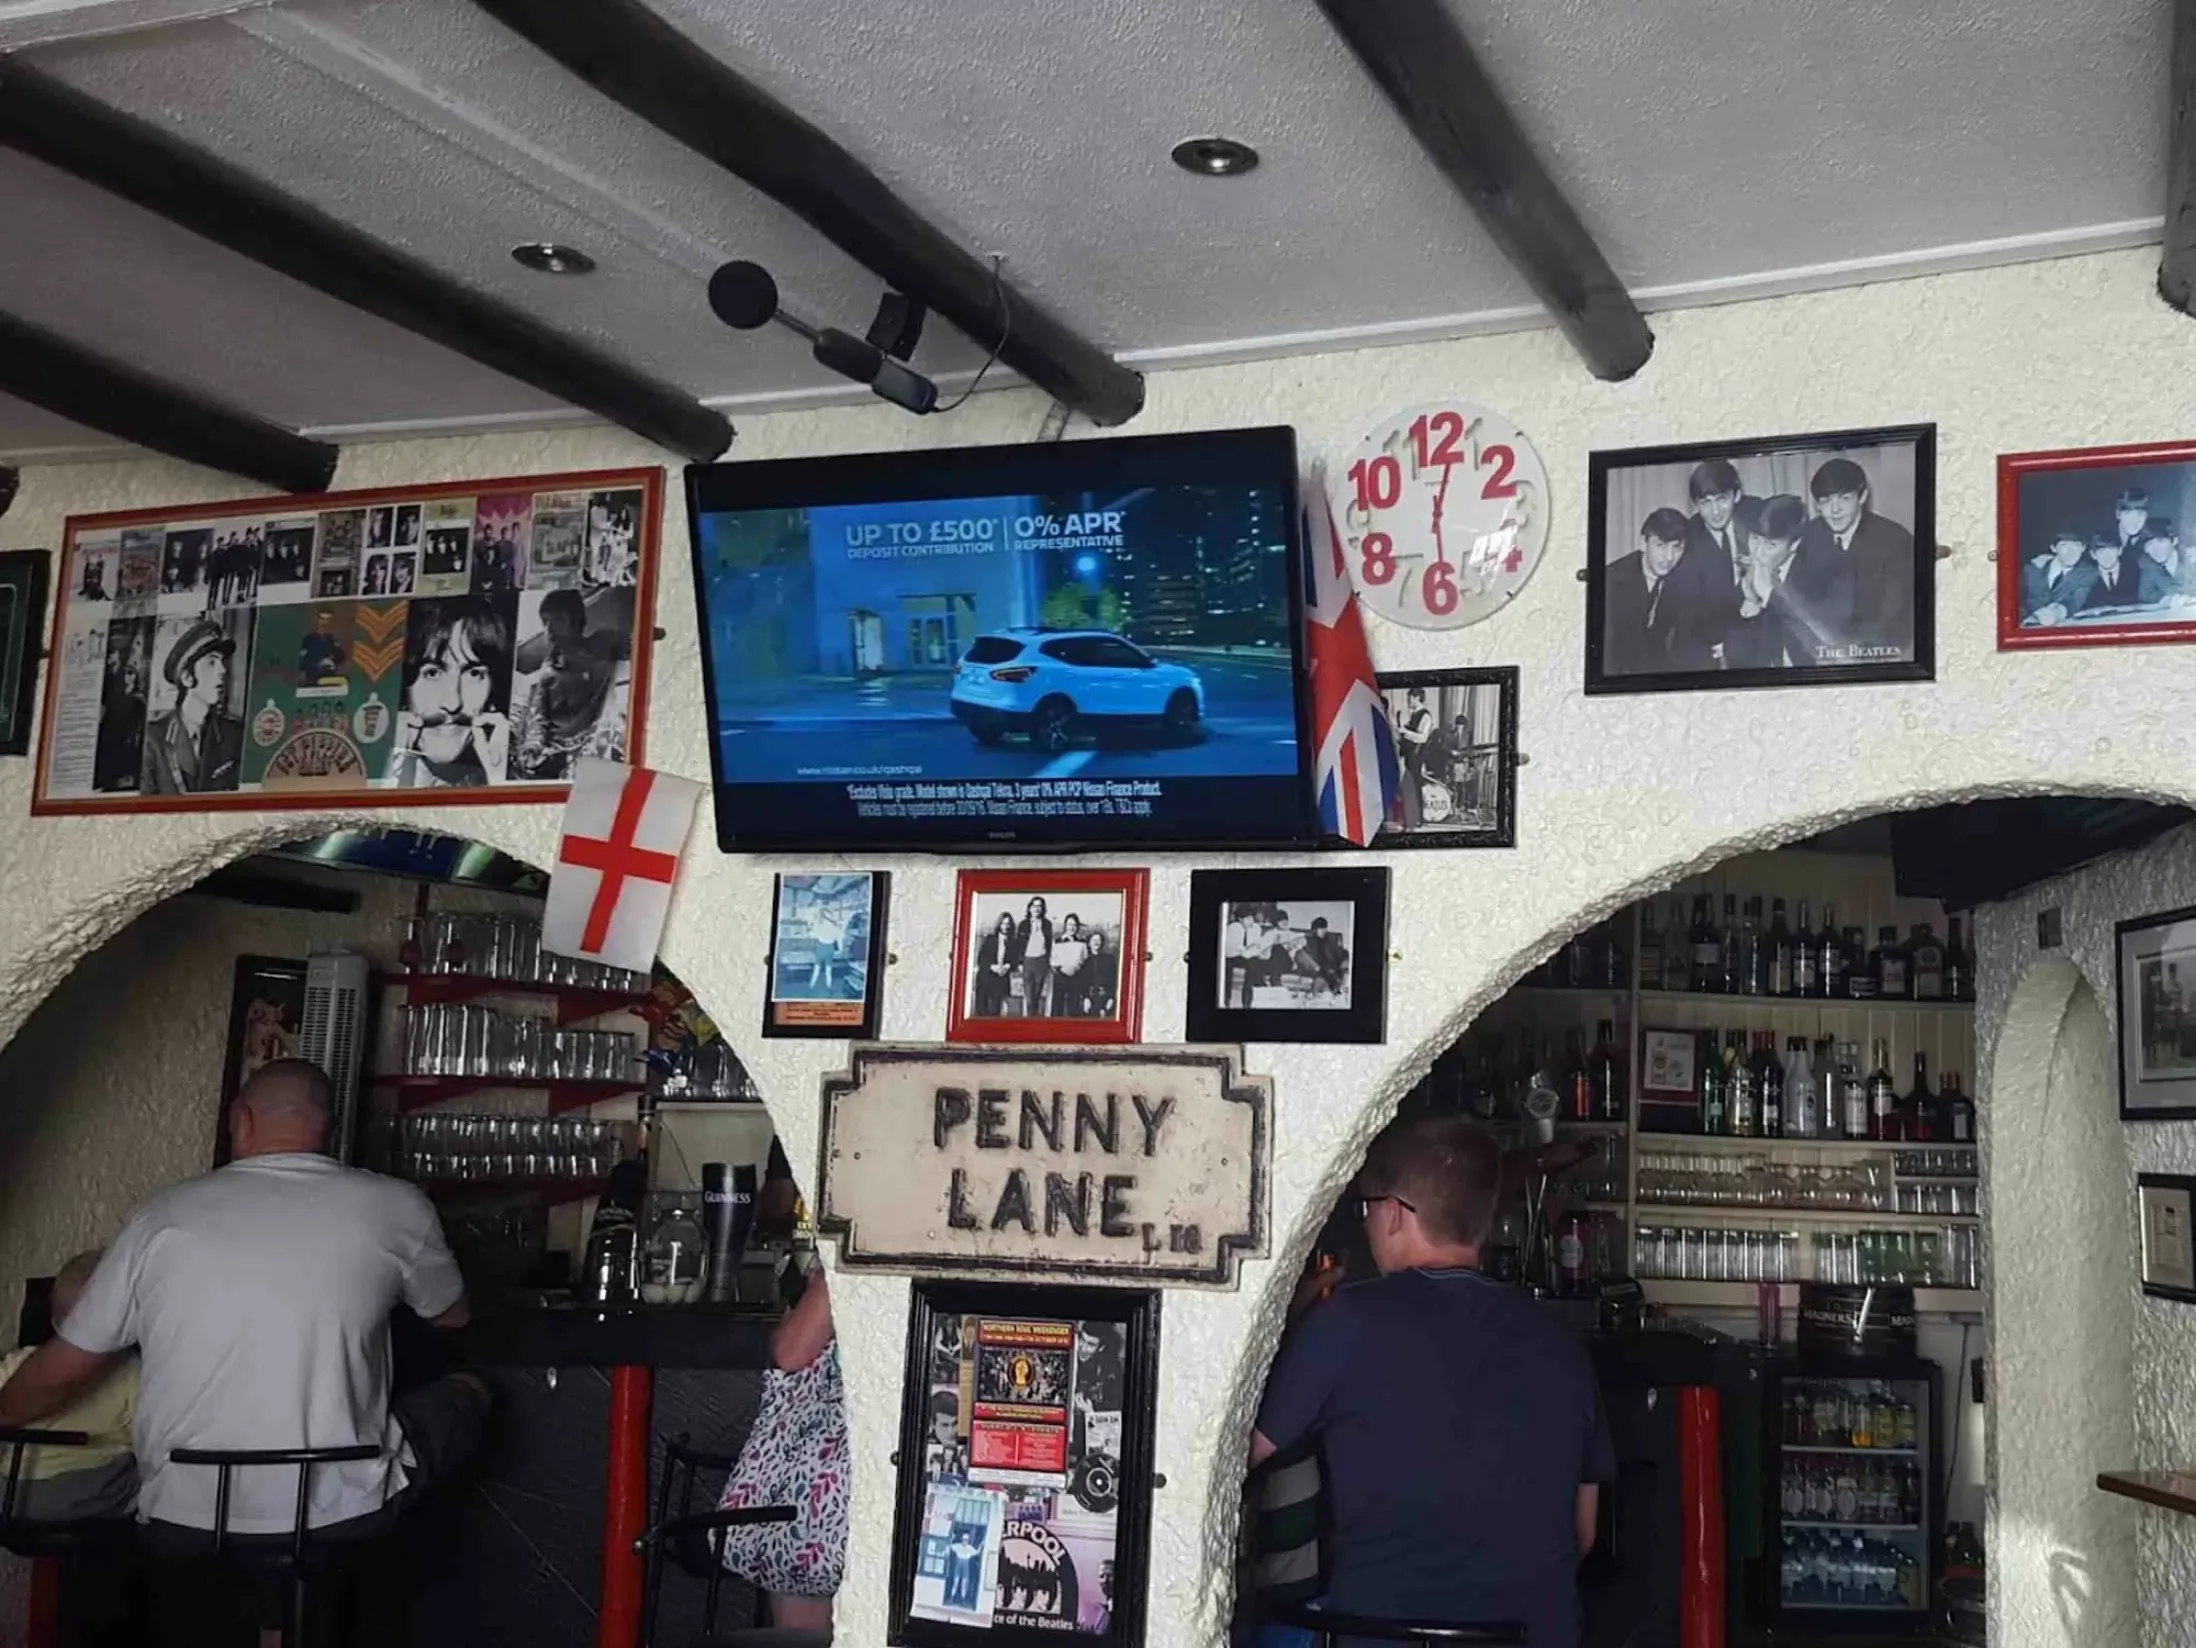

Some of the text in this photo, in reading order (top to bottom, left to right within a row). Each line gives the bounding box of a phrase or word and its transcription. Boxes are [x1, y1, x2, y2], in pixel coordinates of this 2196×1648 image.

[1409, 411, 1464, 467] 12
[1348, 456, 1402, 511] 10
[1480, 444, 1517, 500] 2
[845, 523, 880, 545] UP
[887, 522, 922, 544] TO
[847, 542, 994, 559] DEPOSIT CONTRIBUTION
[1014, 514, 1059, 538] 0%
[1014, 534, 1125, 551] REPRESENTATIVE
[1361, 532, 1396, 586] 8
[1423, 561, 1458, 616] 6
[934, 1086, 1177, 1156] PENNY
[704, 1190, 751, 1204] GUINNESS
[948, 1167, 1138, 1237] LANE
[1002, 1520, 1067, 1566] RPOOL
[1006, 1613, 1018, 1624] of
[1019, 1614, 1036, 1627] the
[1038, 1616, 1074, 1631] Beatles
